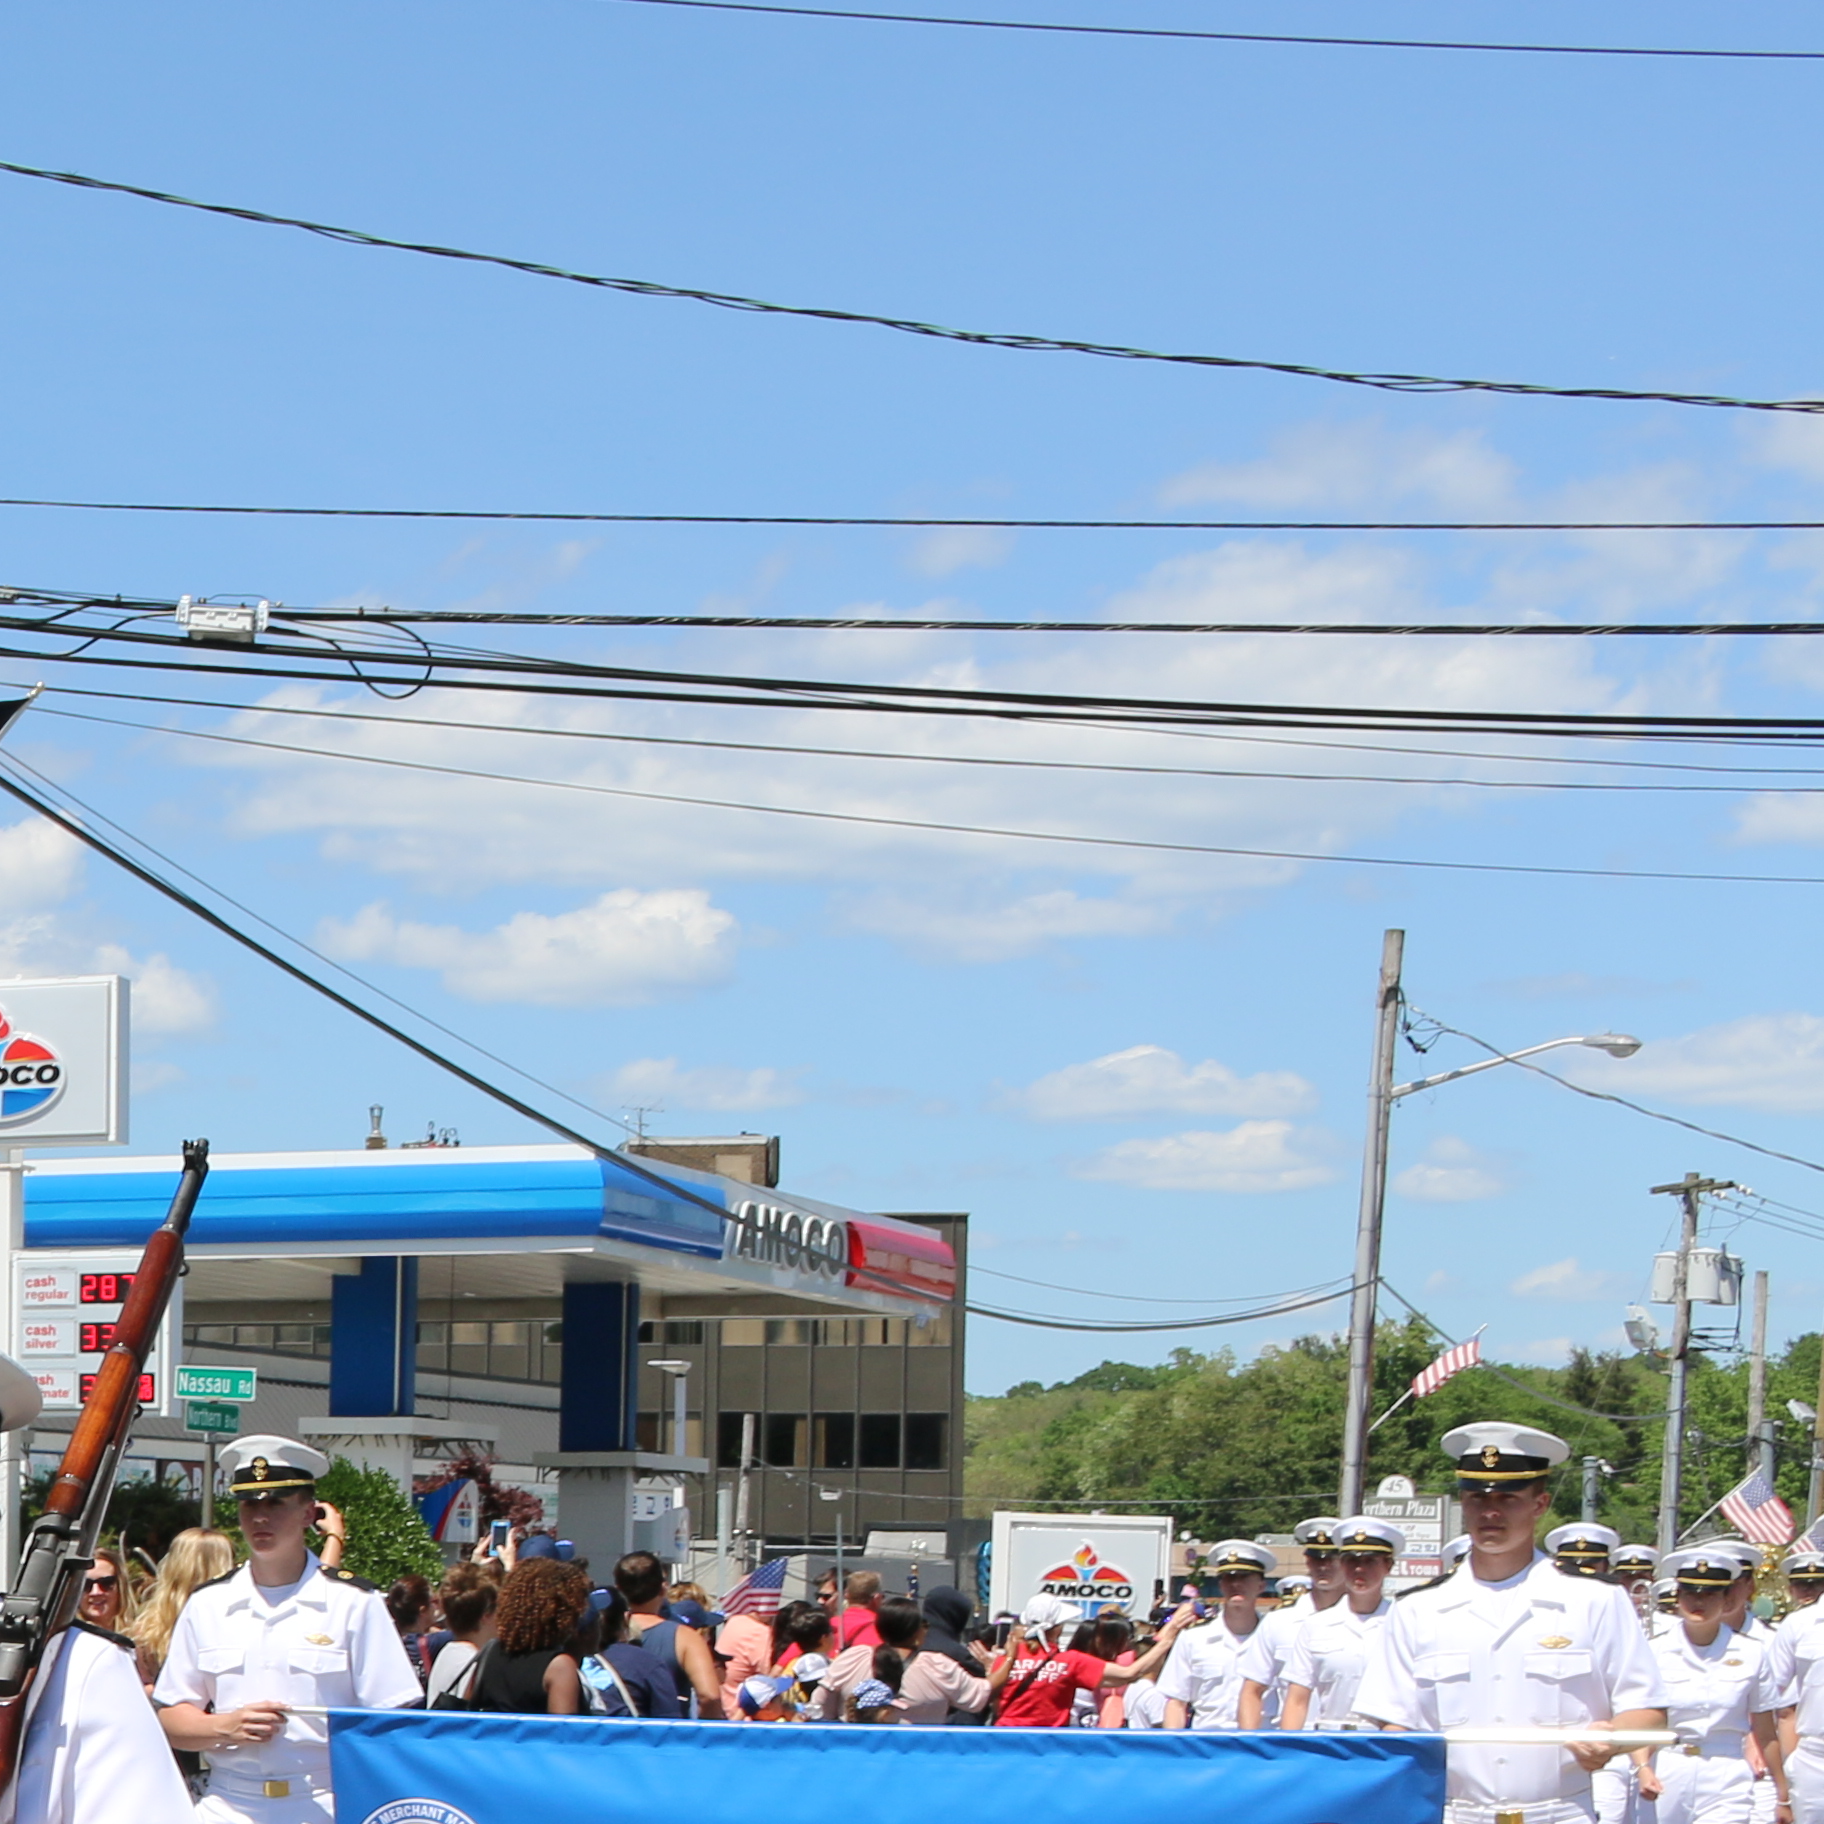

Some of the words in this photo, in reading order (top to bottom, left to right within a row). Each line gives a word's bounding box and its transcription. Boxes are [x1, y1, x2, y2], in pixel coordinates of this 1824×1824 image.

[737, 1200, 844, 1276] AMOCO
[25, 1275, 56, 1288] cash
[25, 1289, 69, 1302] regular
[25, 1325, 56, 1336] cash
[25, 1338, 57, 1349] silver
[34, 1374, 54, 1385] ash
[178, 1372, 231, 1394] Nassau
[238, 1380, 252, 1394] Rd
[1385, 1479, 1404, 1493] 45
[1405, 1500, 1435, 1516] Plaza
[1041, 1584, 1133, 1598] AMOCO
